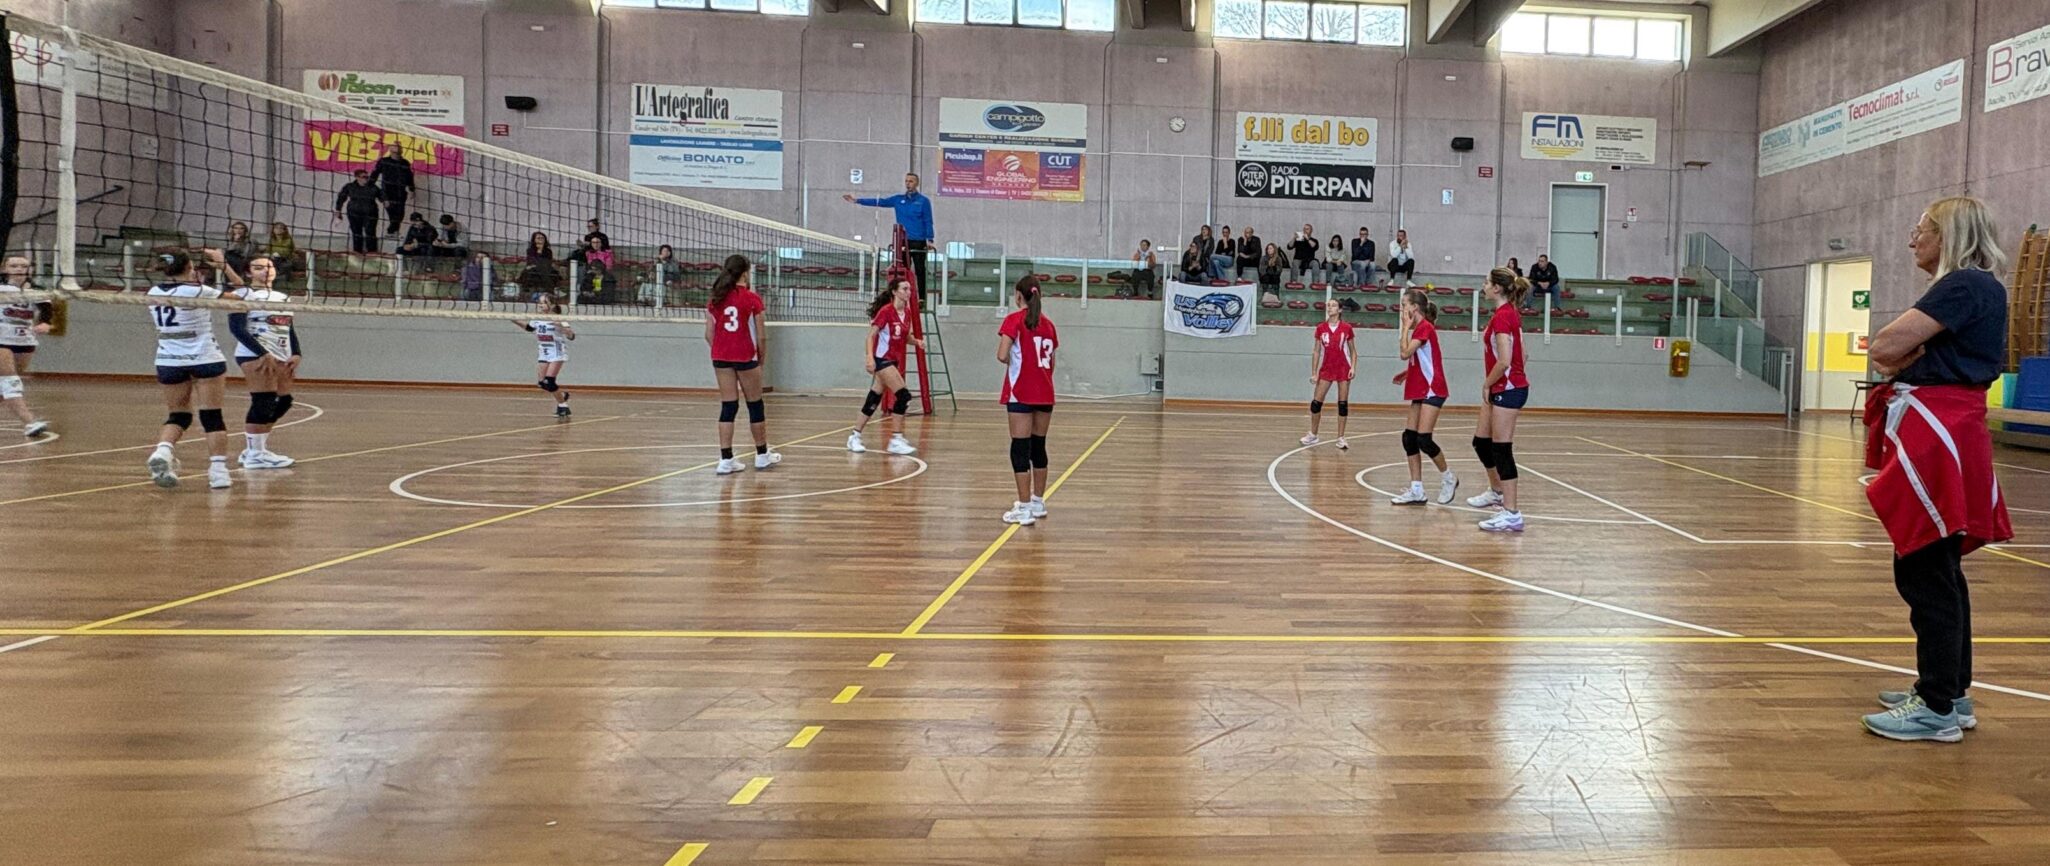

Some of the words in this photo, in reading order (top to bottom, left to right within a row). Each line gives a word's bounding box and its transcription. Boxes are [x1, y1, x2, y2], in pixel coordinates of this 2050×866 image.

[635, 85, 730, 126] L'Artegrafica
[1848, 86, 1905, 122] Tecnoclimat
[988, 113, 1045, 123] campigotto
[1244, 116, 1284, 142] f.lli
[1291, 119, 1331, 145] dal
[1338, 121, 1370, 147] bo
[1531, 138, 1584, 148] INSTALLAZIONI
[683, 154, 745, 165] BONATO
[1047, 155, 1072, 166] CUT
[1242, 171, 1265, 181] PITER
[1271, 165, 1300, 176] RADIO
[986, 176, 1037, 184] ENGINEERING
[1244, 179, 1262, 188] PAN
[1270, 174, 1372, 199] PITERPAN
[1174, 293, 1199, 309] US
[154, 305, 180, 327] 12
[723, 306, 739, 332] 3
[1182, 311, 1235, 331] Volley
[1033, 335, 1054, 370] 13
